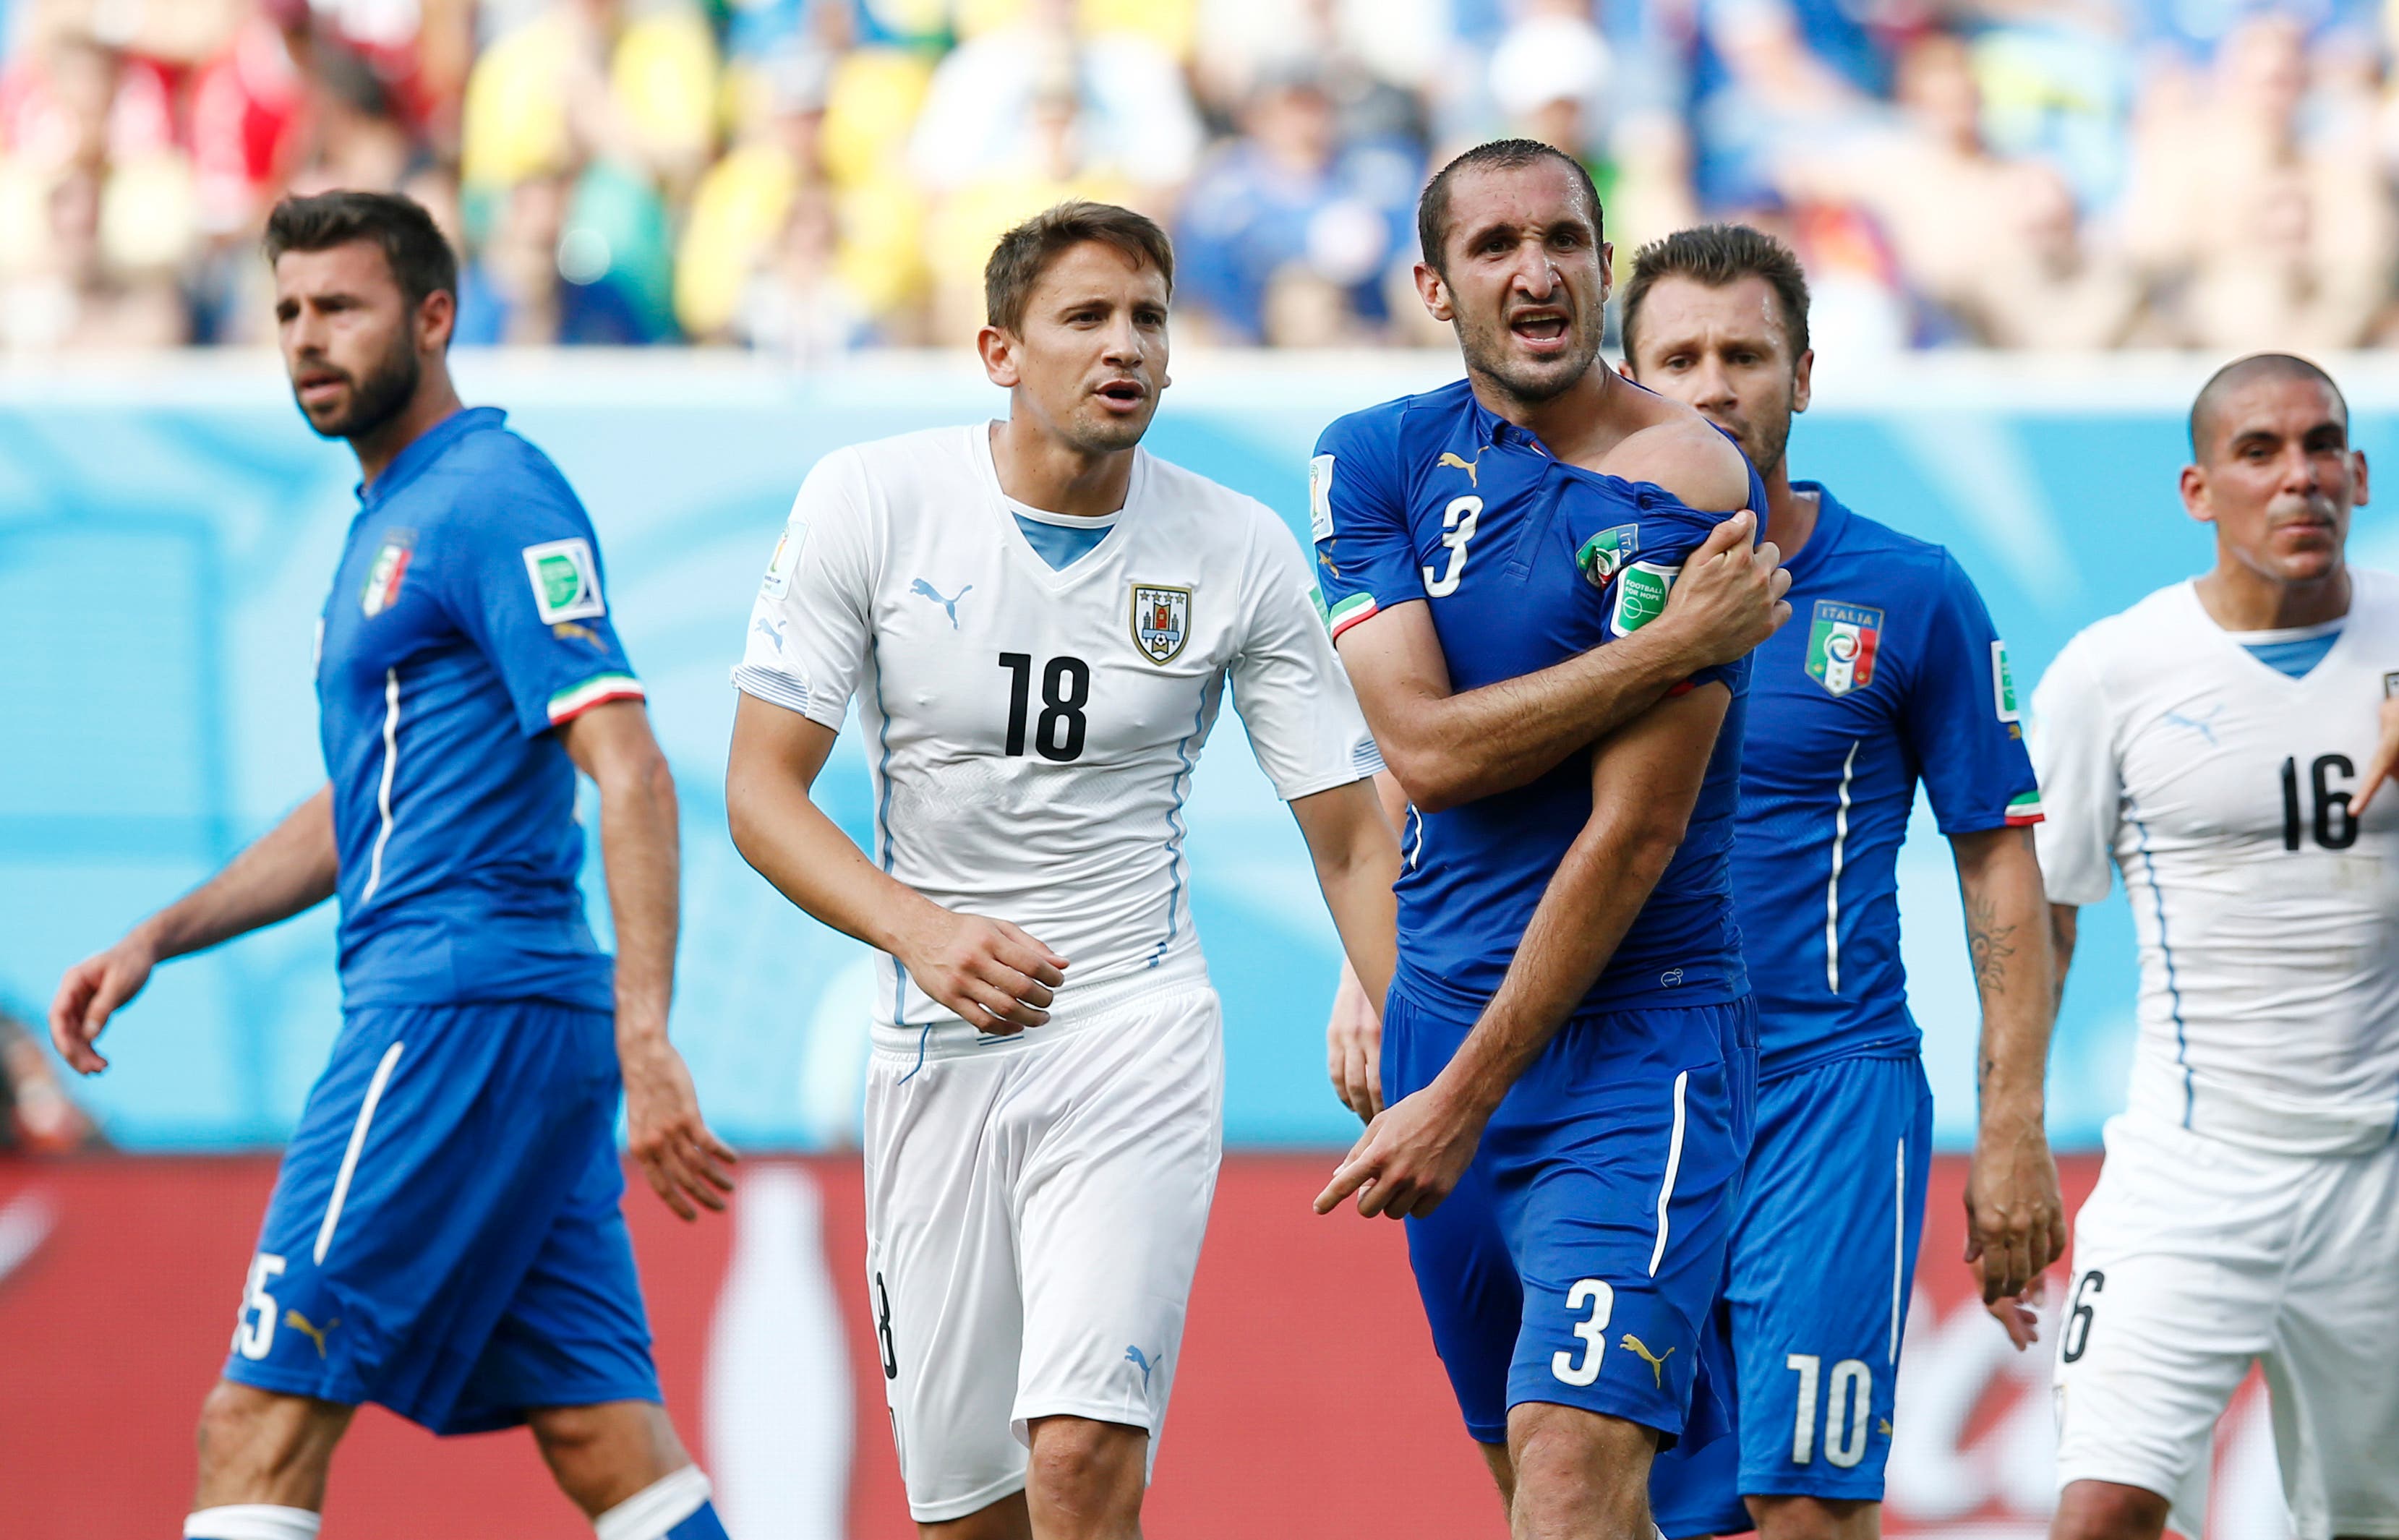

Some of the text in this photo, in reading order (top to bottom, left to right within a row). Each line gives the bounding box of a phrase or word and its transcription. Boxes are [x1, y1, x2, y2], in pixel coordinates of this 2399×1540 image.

[1421, 494, 1484, 599] 3
[1620, 532, 1632, 558] ITA
[1625, 586, 1661, 602] FOR HOPE
[1626, 578, 1662, 594] FOOTBALL
[1821, 607, 1874, 627] ITALIA
[998, 651, 1090, 762] 18
[2281, 753, 2359, 851] 16
[1551, 1278, 1615, 1387] 3
[1785, 1352, 1873, 1469] 10
